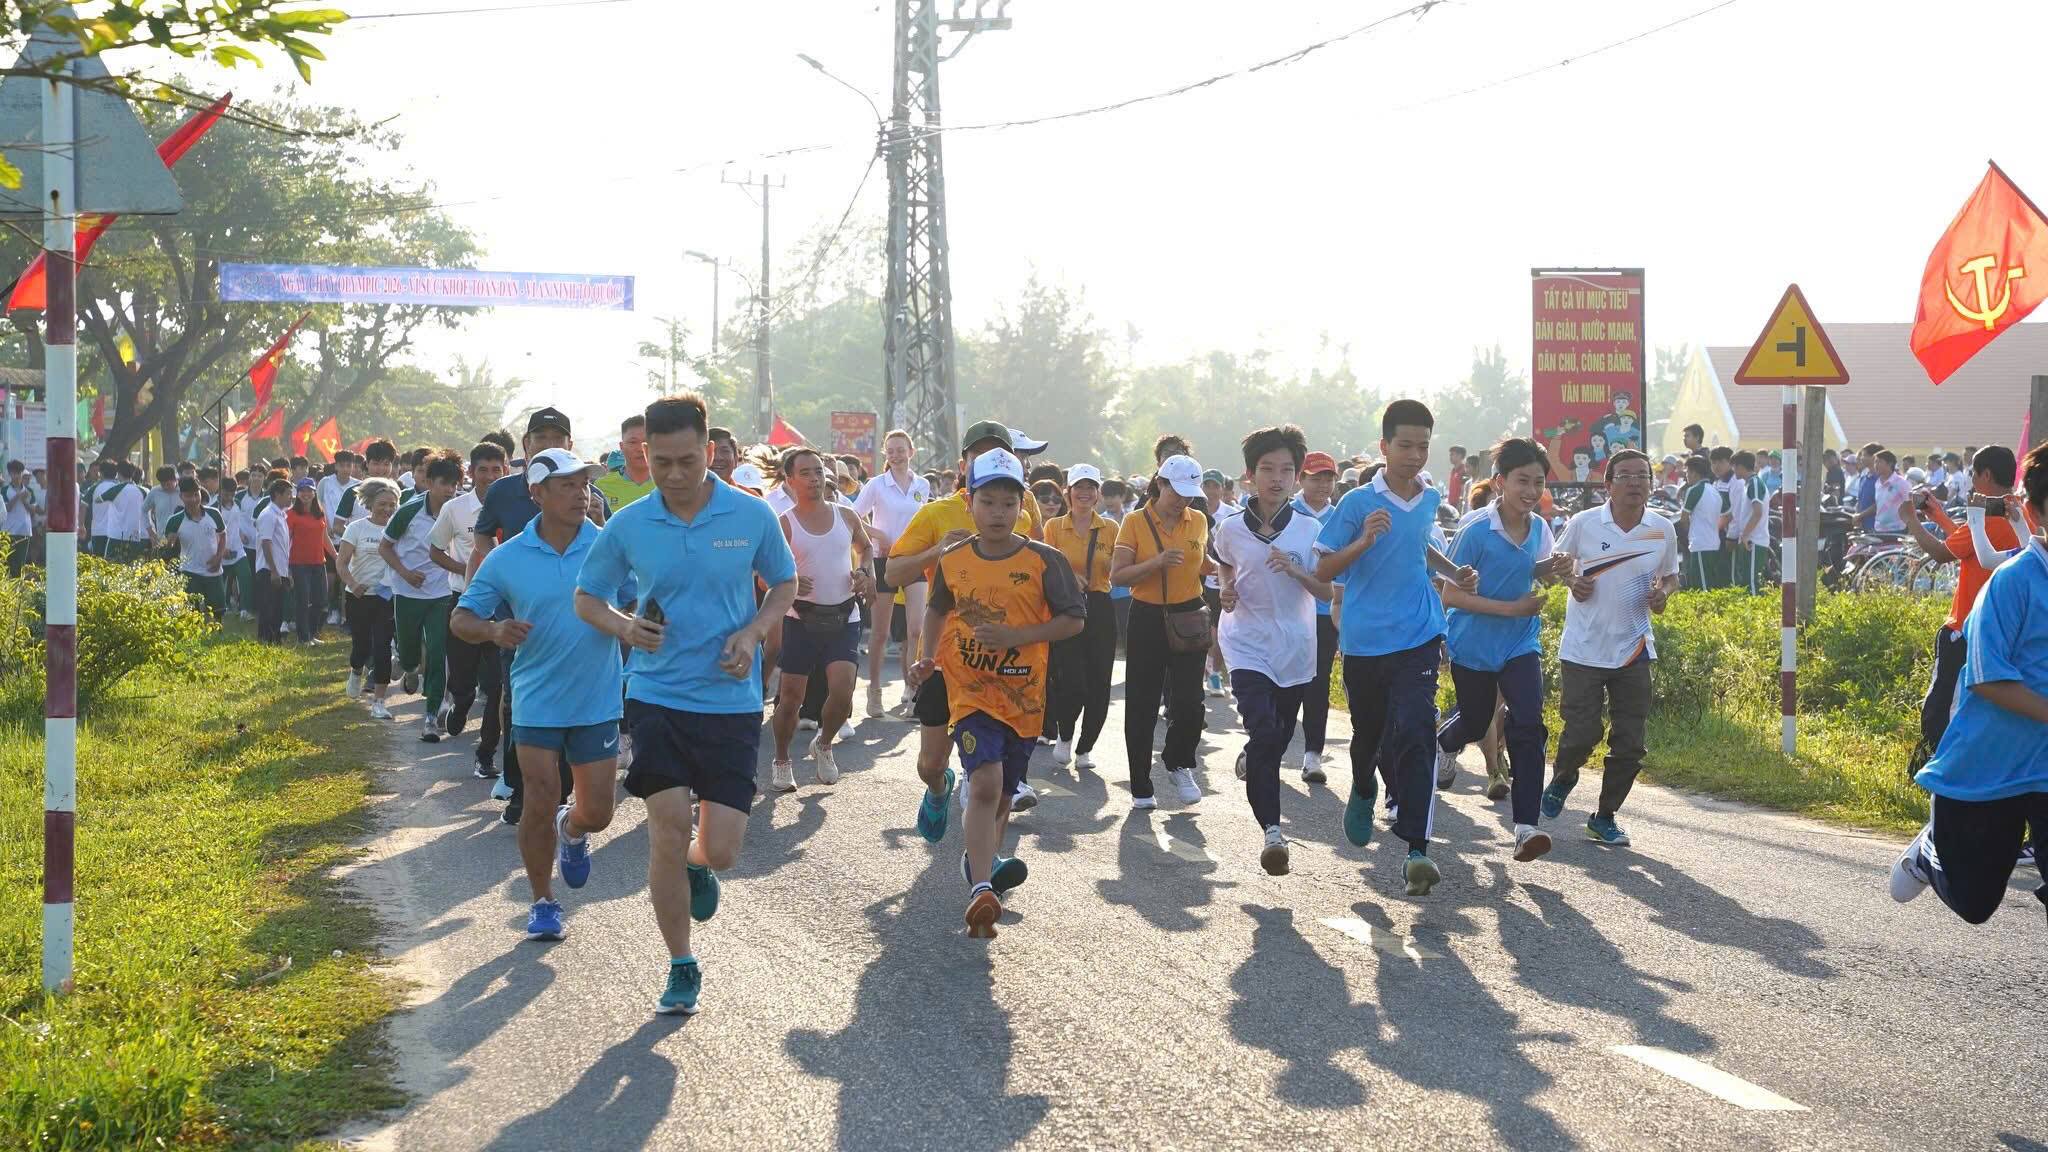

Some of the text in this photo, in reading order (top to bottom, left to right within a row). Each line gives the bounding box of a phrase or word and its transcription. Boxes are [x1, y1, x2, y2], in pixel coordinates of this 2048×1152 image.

[337, 275, 380, 293] OLYMPIC
[1544, 284, 1628, 314] TẤT CẢ VÌ MỤC TIÊU
[1535, 318, 1637, 345] DÂN GIÀU, NƯỚC MẠNH,
[1537, 346, 1634, 373] DÂN CHỦ, CÔNG BẰNG,
[1561, 381, 1579, 403] VĂN
[1581, 384, 1605, 403] MINH
